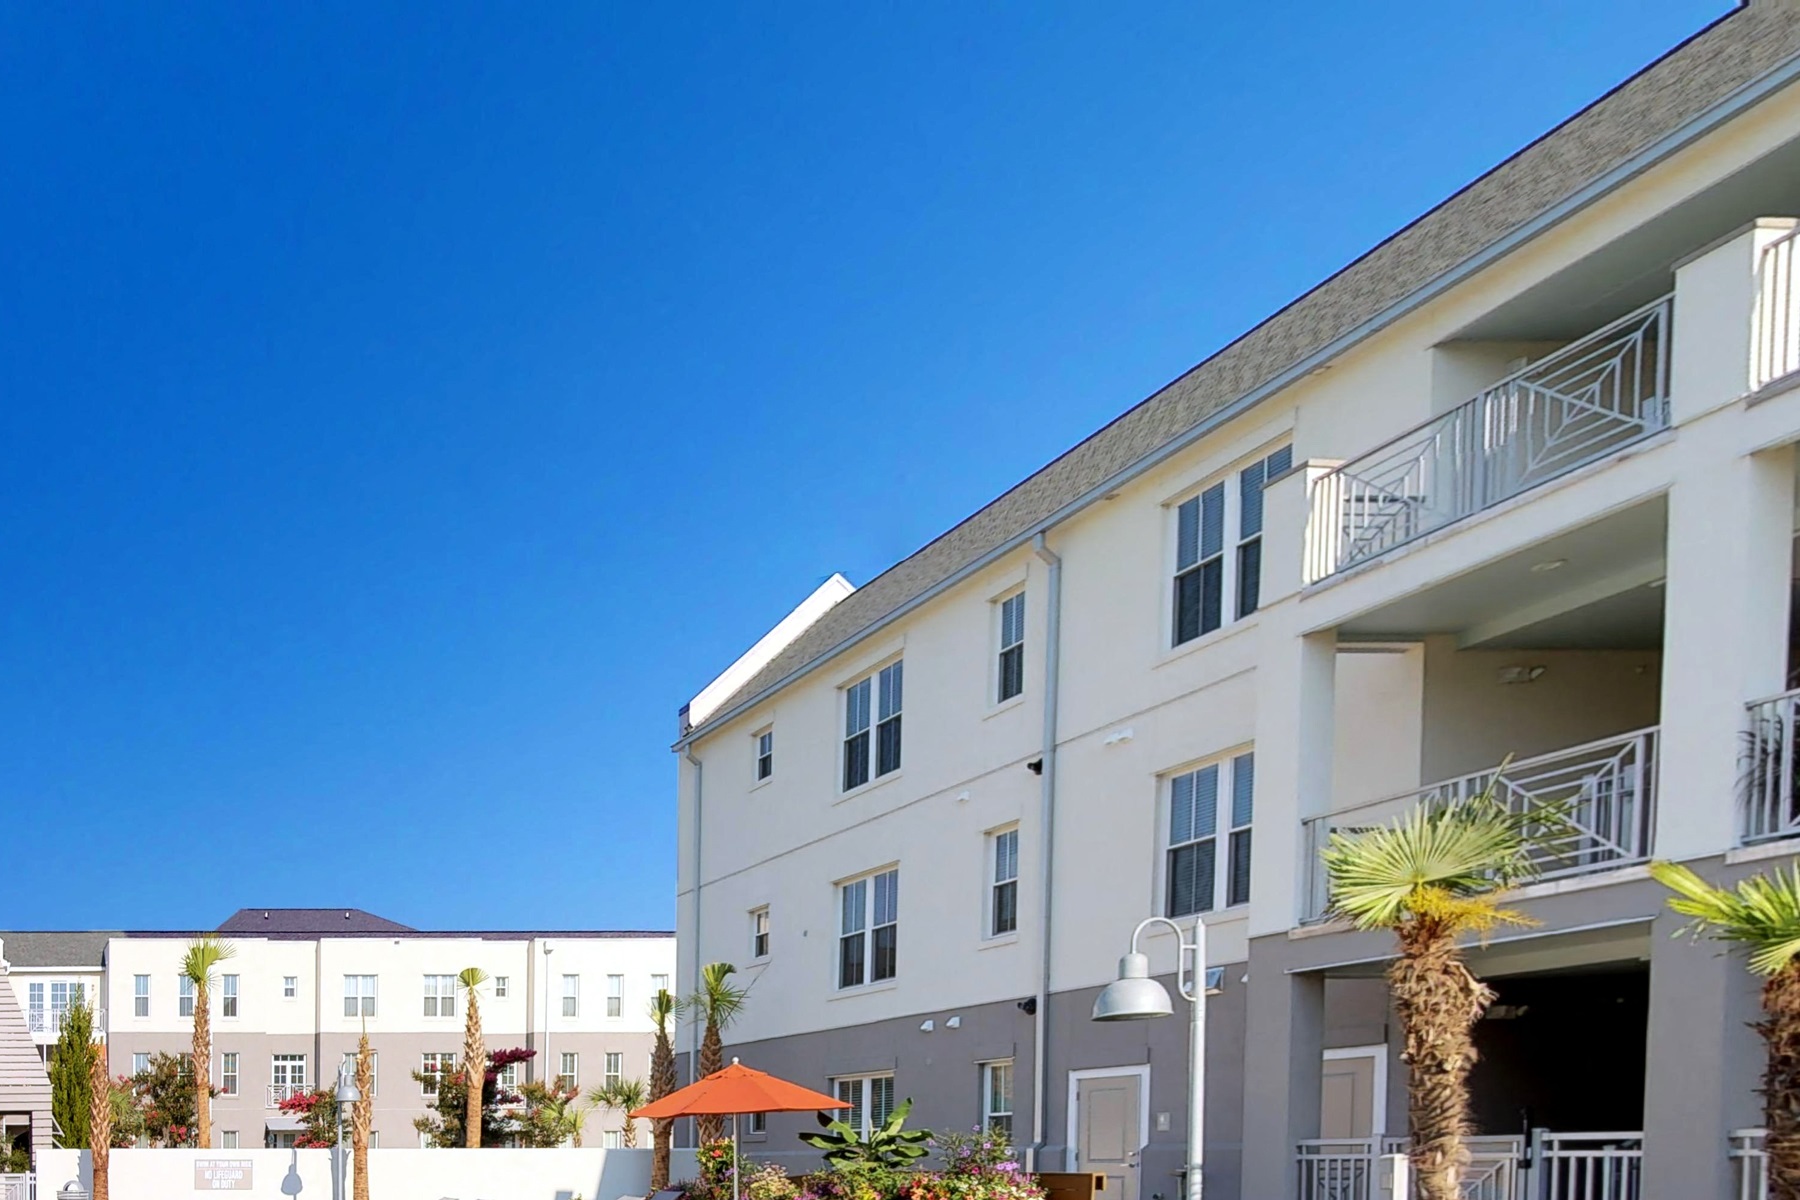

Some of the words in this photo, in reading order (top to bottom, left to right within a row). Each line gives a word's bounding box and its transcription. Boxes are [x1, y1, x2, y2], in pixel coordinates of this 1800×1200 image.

[204, 1170, 213, 1179] NO
[213, 1170, 243, 1179] LIFEGUARD
[221, 1179, 236, 1189] DUTY
